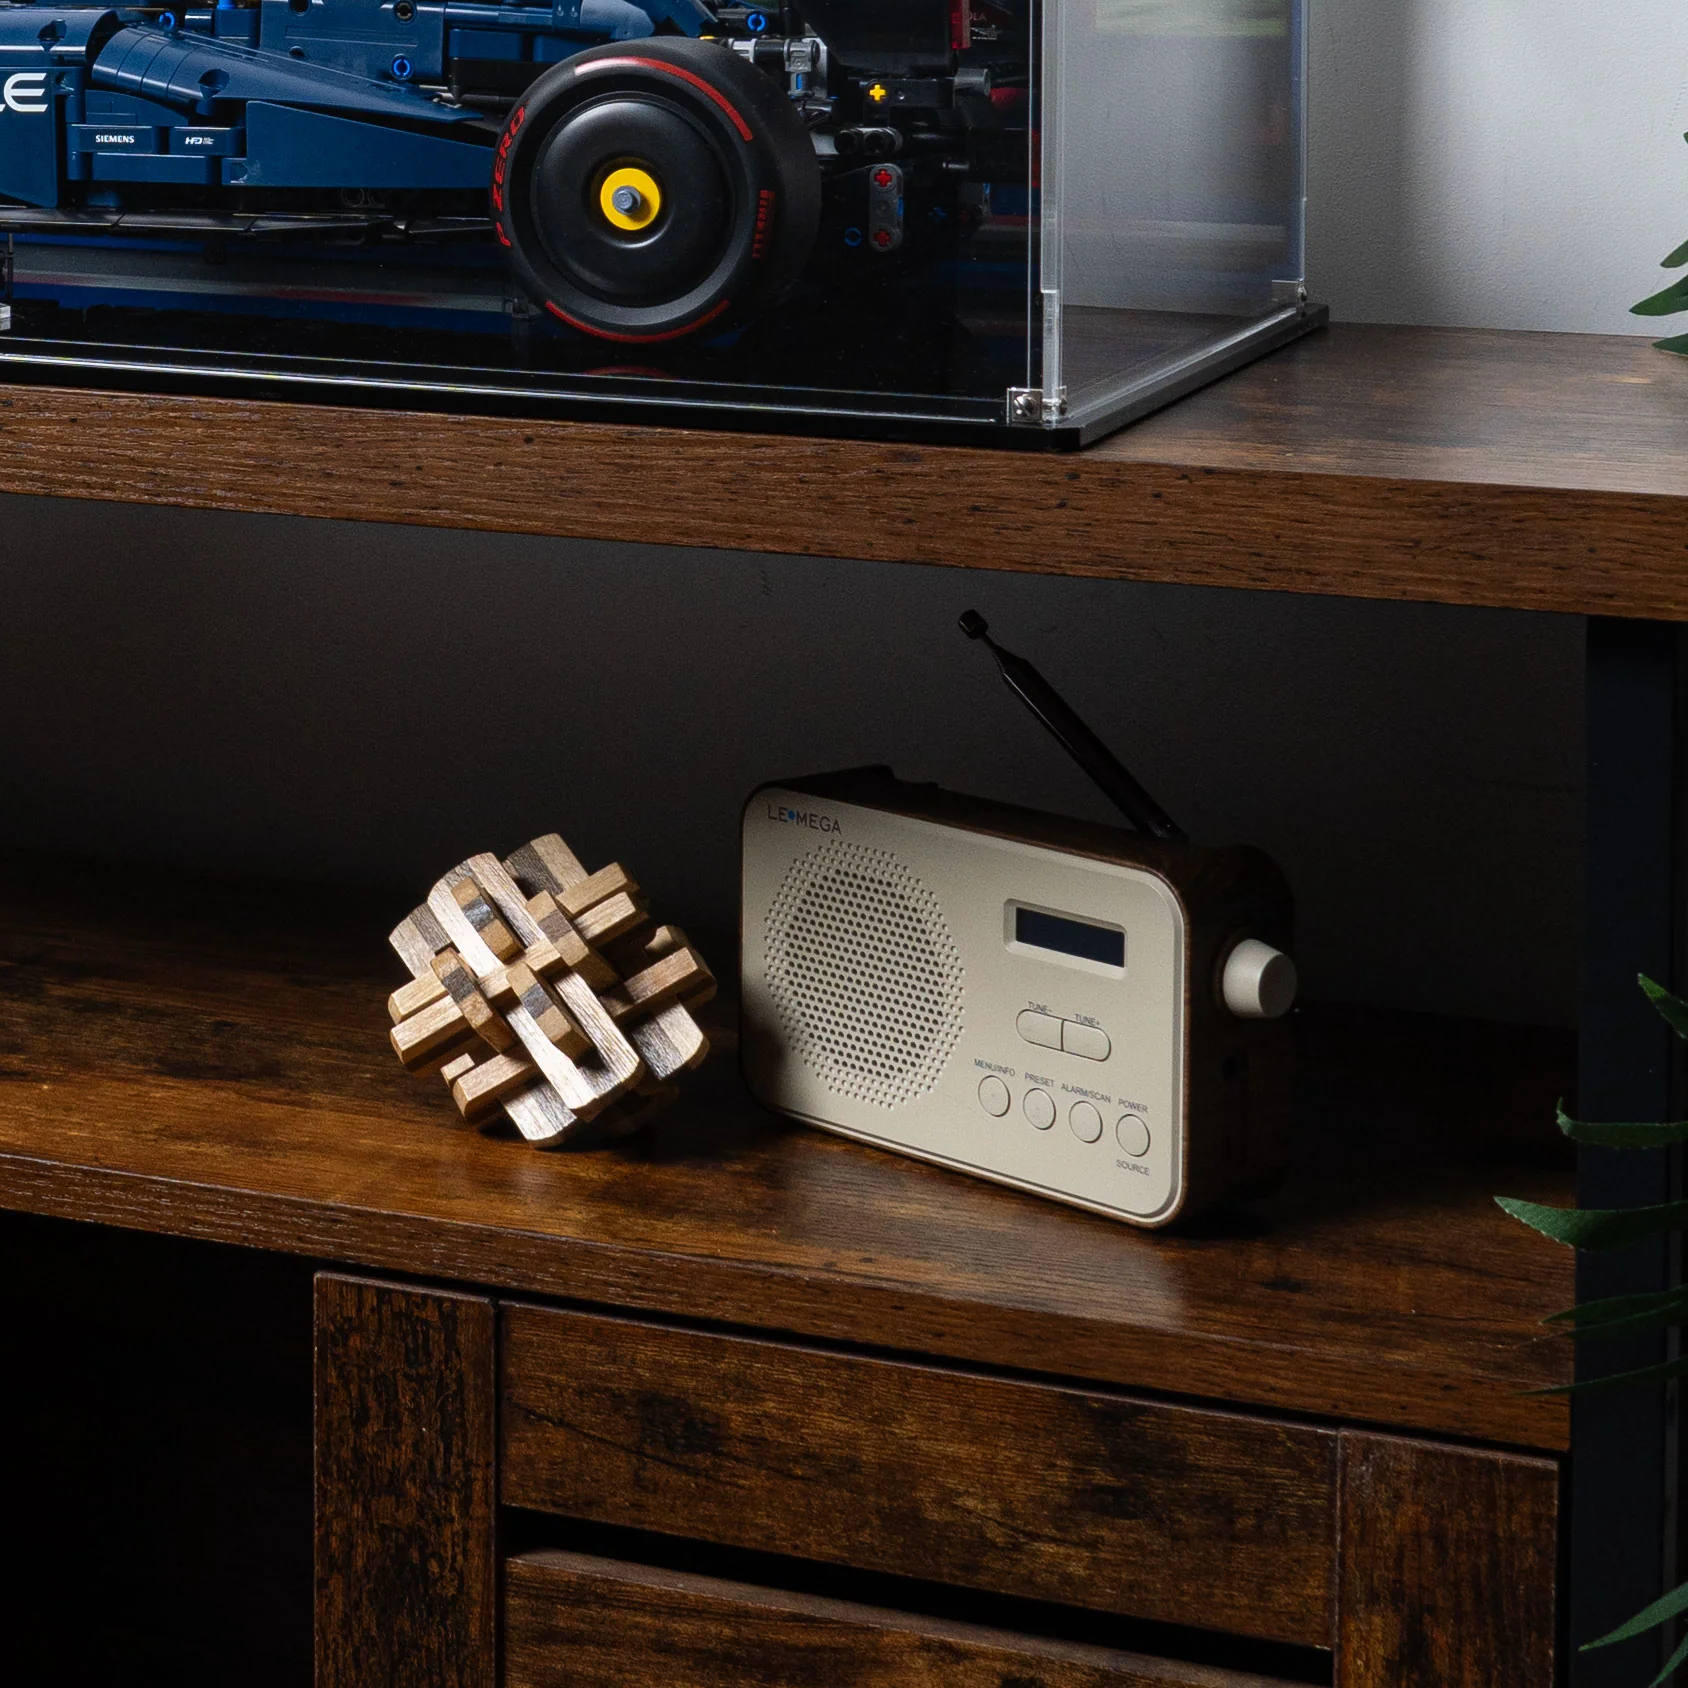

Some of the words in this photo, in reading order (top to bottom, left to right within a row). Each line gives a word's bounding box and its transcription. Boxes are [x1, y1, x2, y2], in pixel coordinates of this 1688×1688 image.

[95, 134, 135, 144] SIEMENS
[493, 105, 525, 212] ZERO
[1024, 1072, 1055, 1088] PRESET
[1117, 1097, 1149, 1114] POWER
[1116, 1159, 1150, 1177] SOURCE
